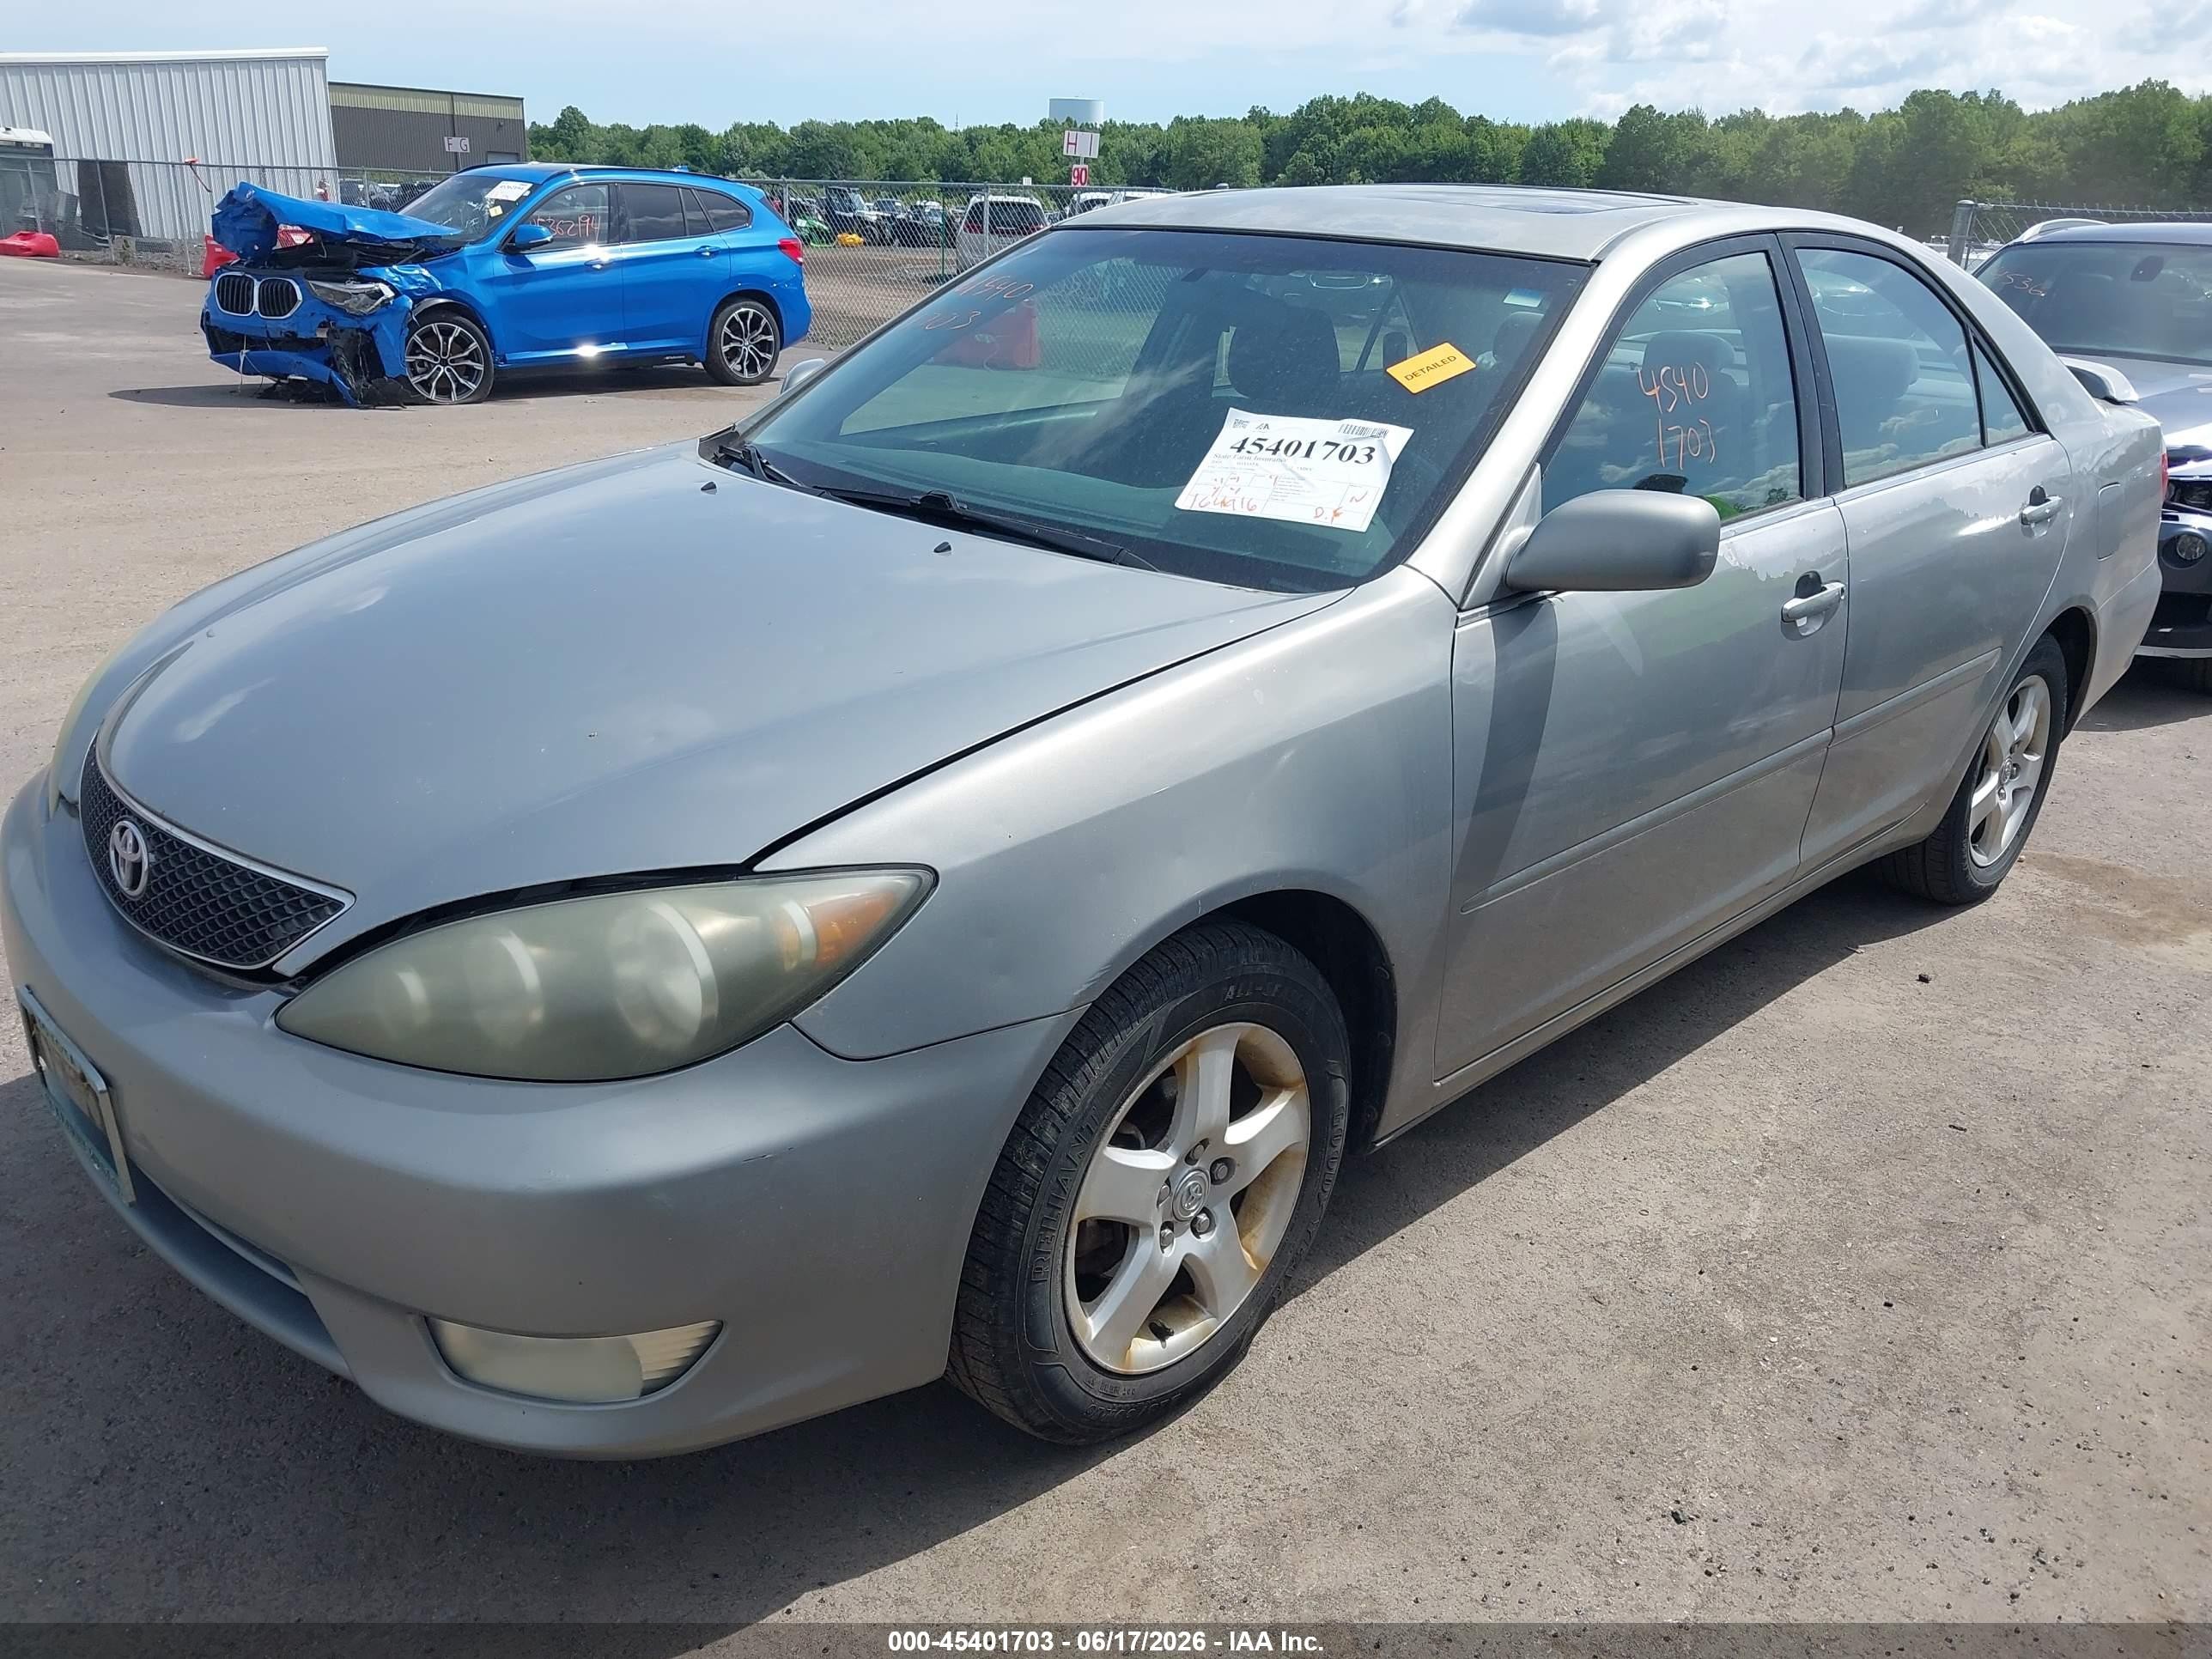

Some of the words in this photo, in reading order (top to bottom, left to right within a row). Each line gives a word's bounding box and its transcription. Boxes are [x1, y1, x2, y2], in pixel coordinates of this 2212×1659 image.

[447, 137, 453, 151] F
[459, 137, 468, 152] G
[1066, 131, 1078, 155] H
[1072, 167, 1087, 186] 90
[1404, 355, 1457, 381] DETAILED
[1638, 361, 1709, 415] 4540
[1229, 436, 1376, 465] 45401703
